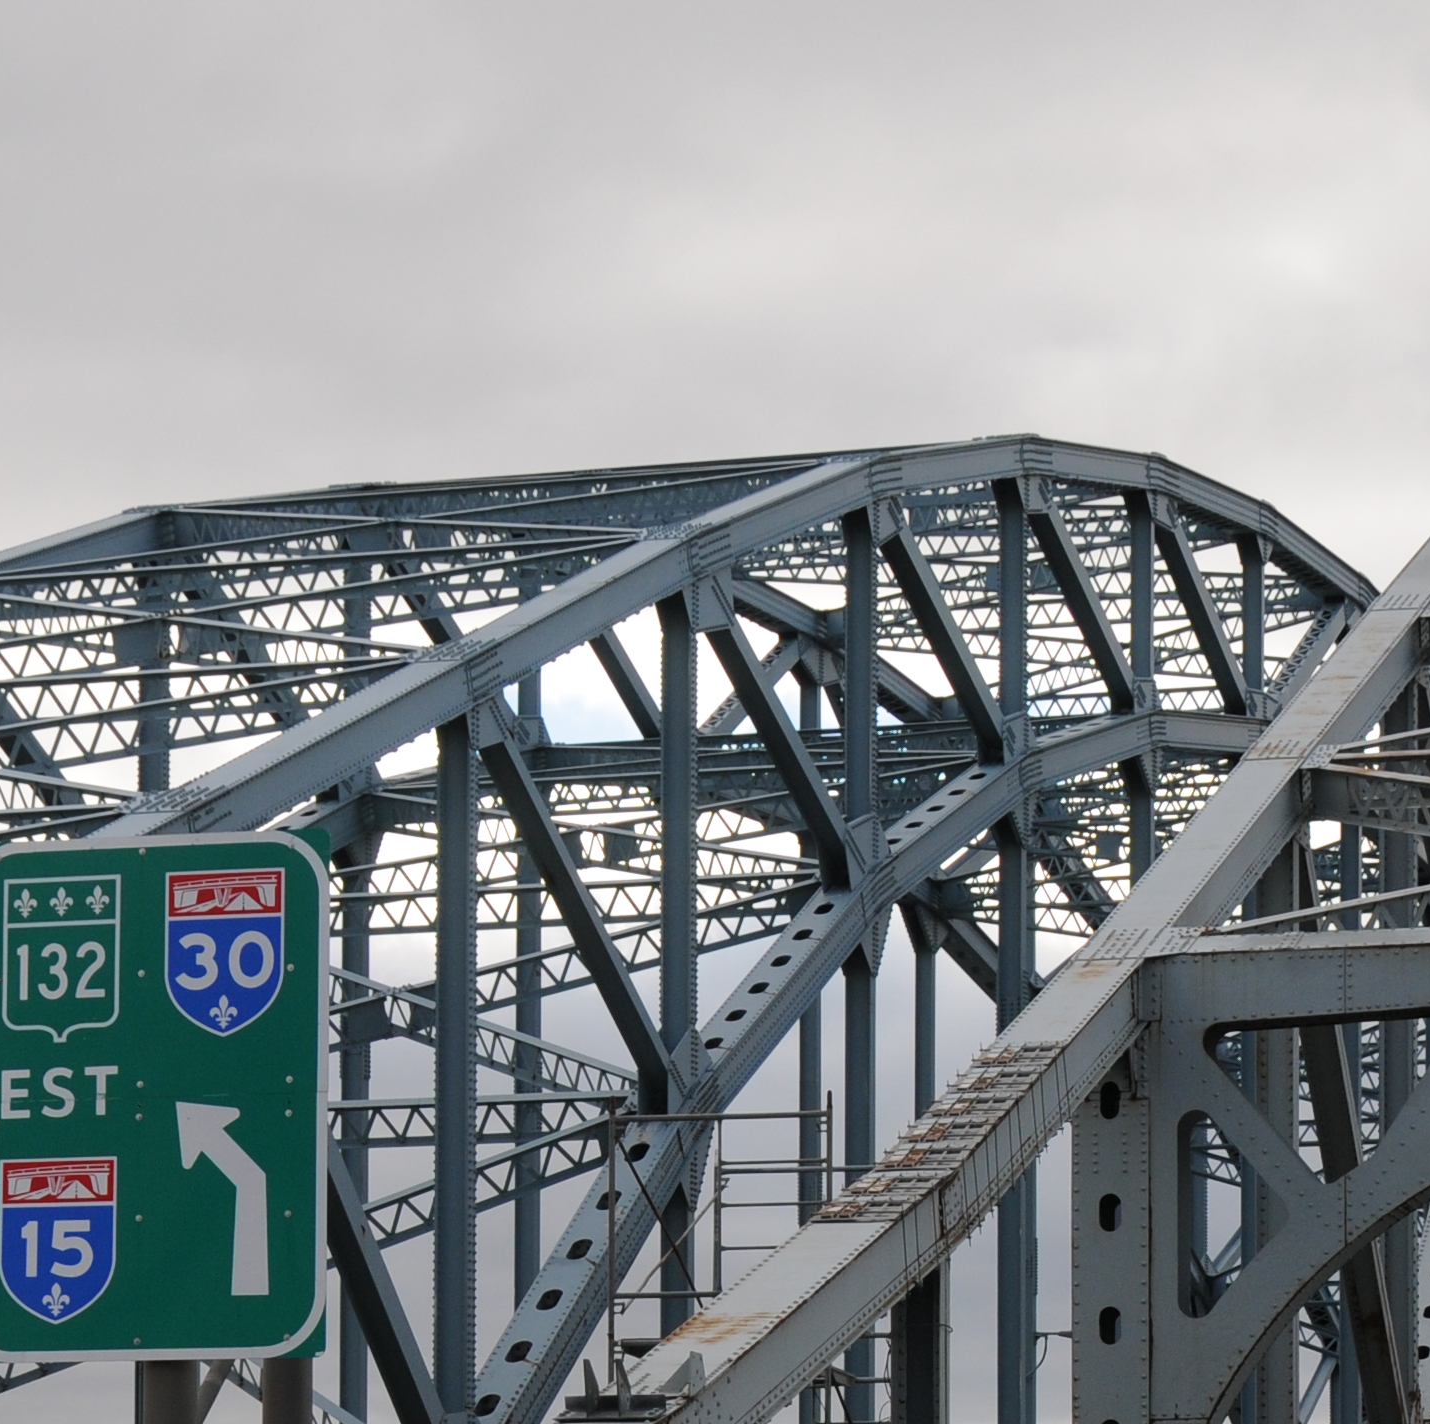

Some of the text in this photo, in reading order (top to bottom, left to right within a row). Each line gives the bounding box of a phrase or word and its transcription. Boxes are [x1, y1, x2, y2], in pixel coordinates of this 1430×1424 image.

[15, 941, 106, 1001] 132
[174, 930, 275, 991] 30
[0, 1065, 119, 1121] EST
[20, 1219, 95, 1279] 15
